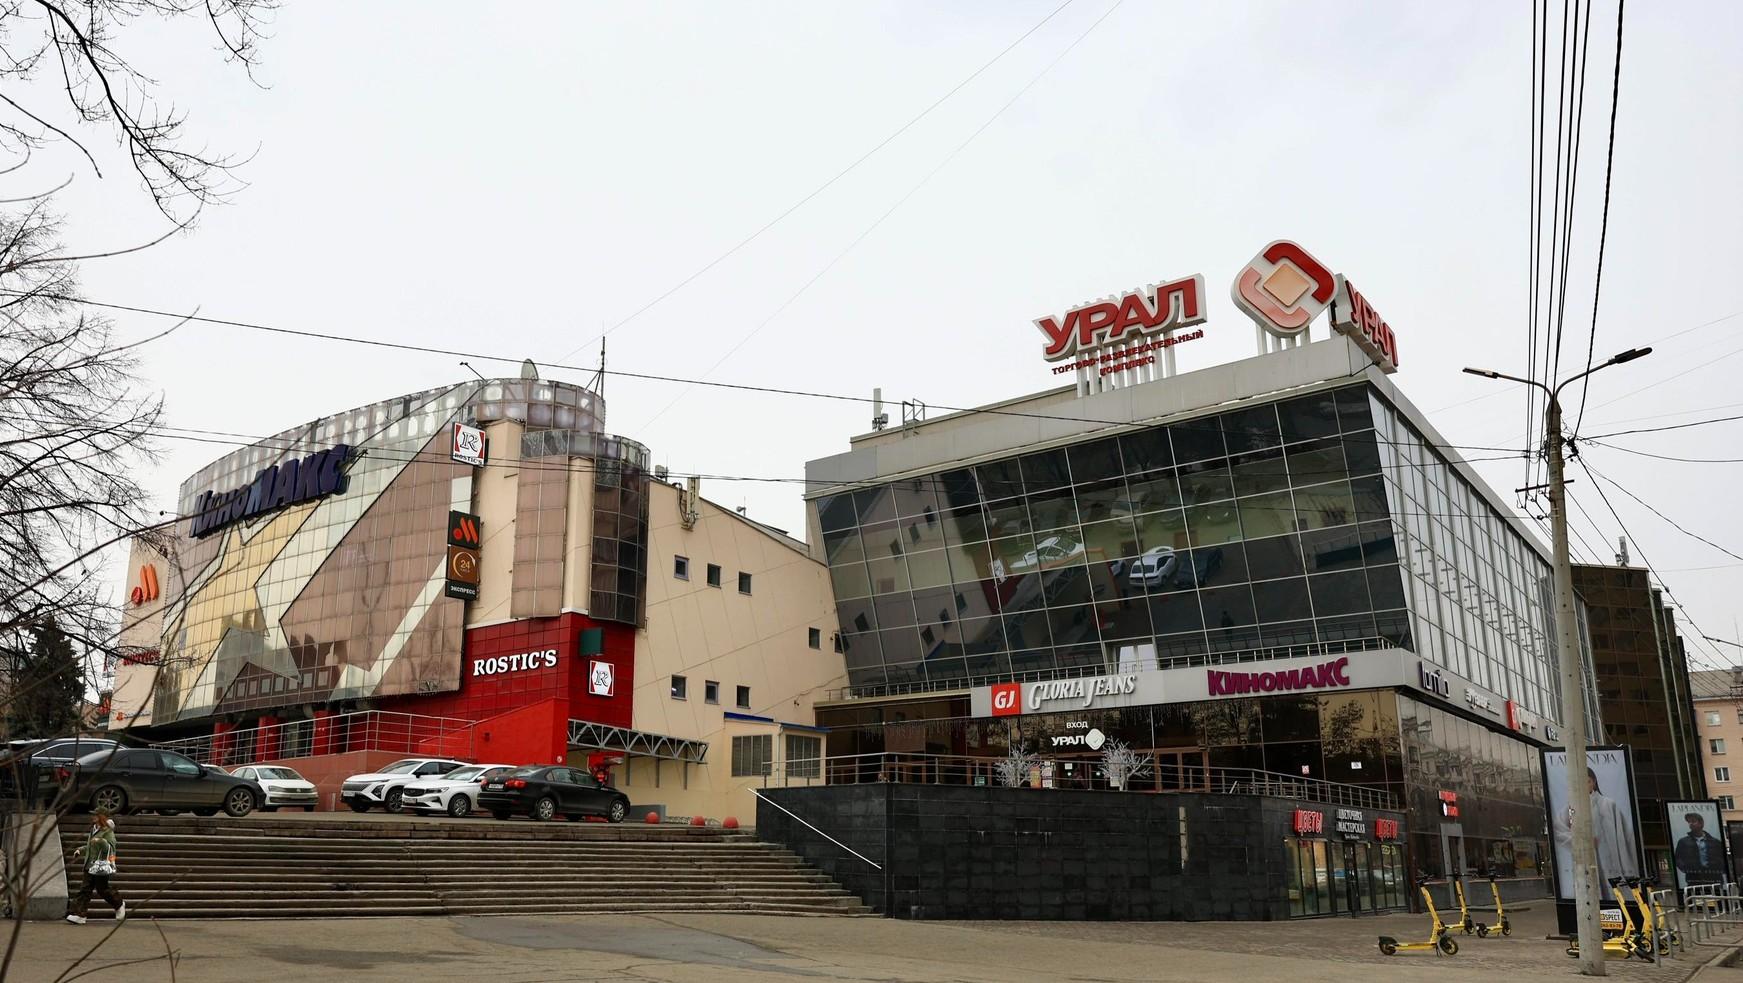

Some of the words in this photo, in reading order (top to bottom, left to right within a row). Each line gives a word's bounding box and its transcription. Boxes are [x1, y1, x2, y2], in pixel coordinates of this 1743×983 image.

[1037, 279, 1199, 356] УРАЛ
[1345, 279, 1398, 367] УРАЛ
[1051, 329, 1204, 375] ТОРГОВО-РАЗВЛЕКАТЕЛЬНЫЙ
[1099, 355, 1155, 377] КОМПЛЕКС
[460, 559, 471, 570] 24
[450, 585, 476, 595] ЭКСПРЕСС
[473, 649, 557, 676] ROSTIC'S
[1207, 657, 1350, 696] КИНОМАКС
[994, 690, 1016, 709] GJ
[1028, 679, 1085, 712] GLORIA
[1083, 675, 1137, 707] JEANS
[1066, 721, 1089, 729] ВХОД
[1051, 735, 1085, 746] УРАЛ
[1295, 809, 1323, 834] ЦВЕТЫ
